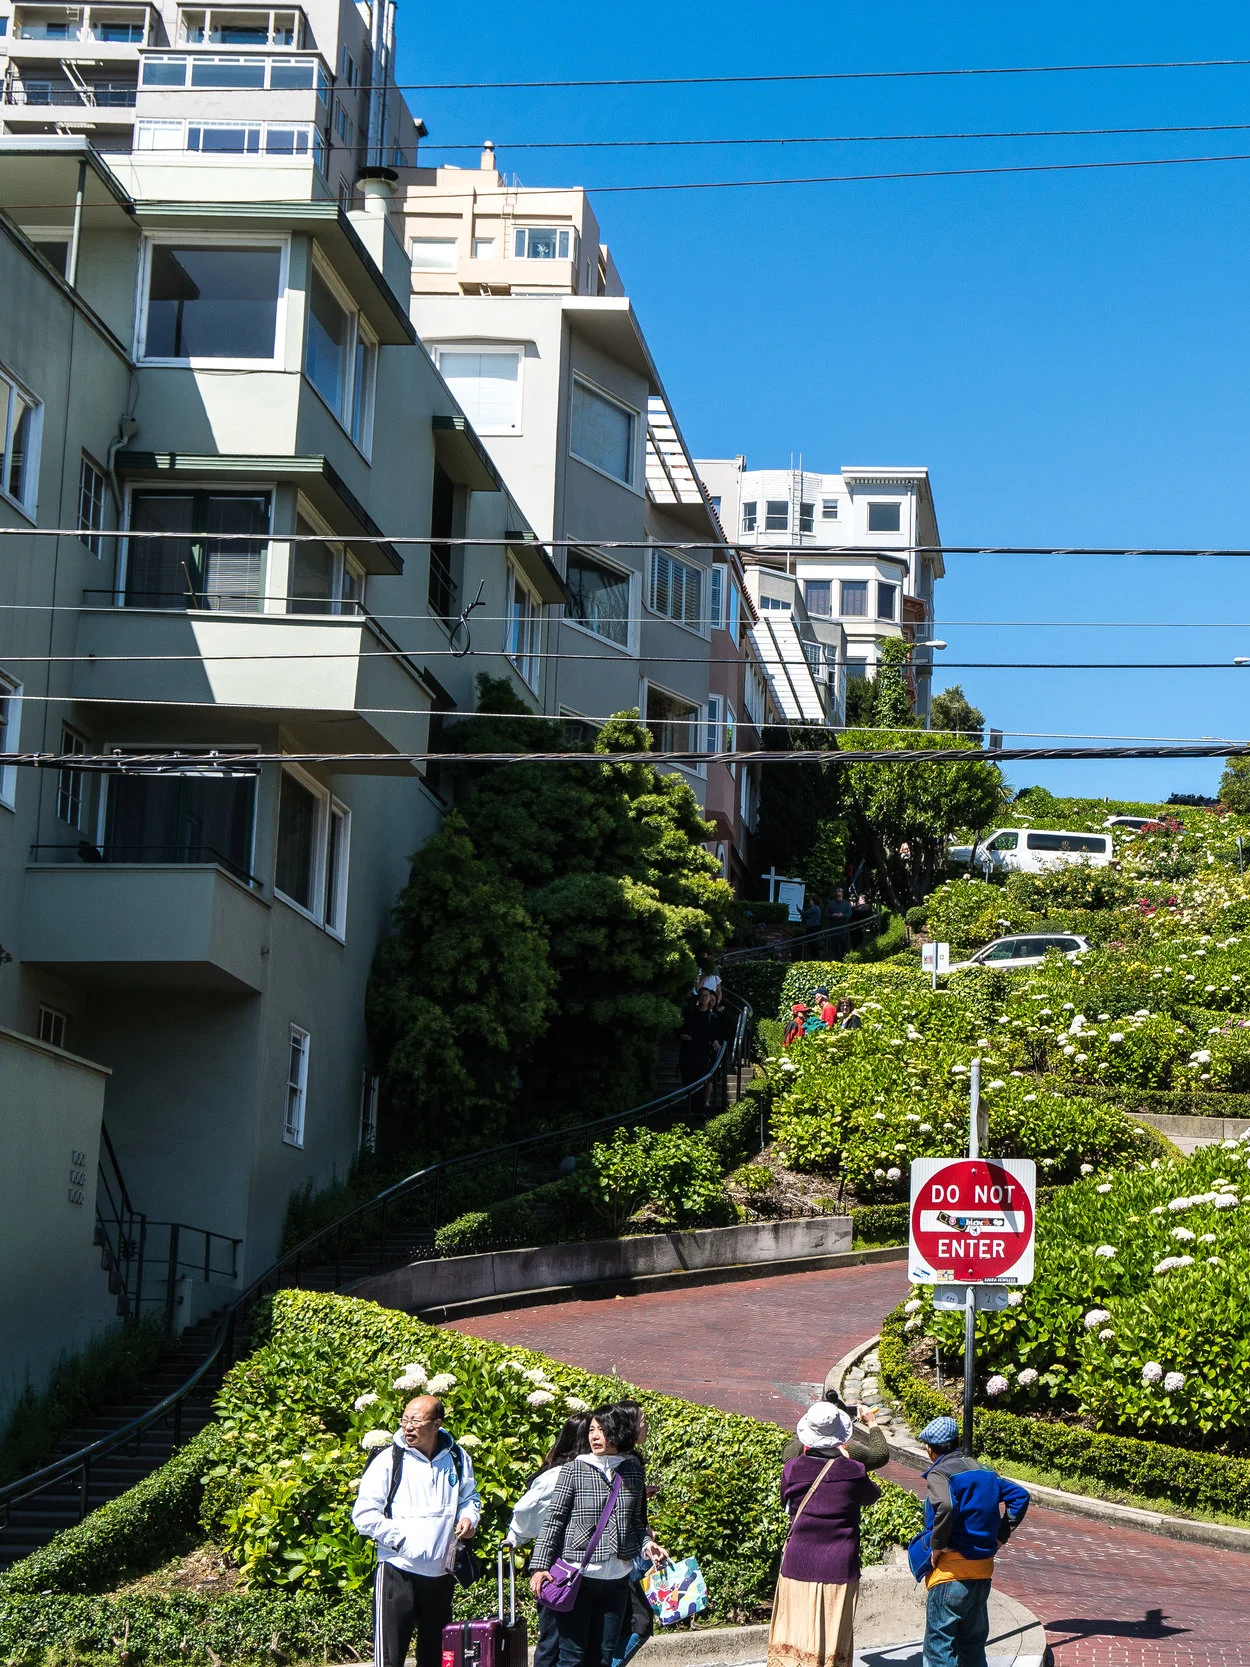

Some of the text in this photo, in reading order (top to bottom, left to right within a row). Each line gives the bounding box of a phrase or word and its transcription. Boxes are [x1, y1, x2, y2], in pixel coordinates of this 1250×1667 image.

[931, 1185, 1015, 1204] DO NOT
[938, 1239, 1005, 1258] ENTER
